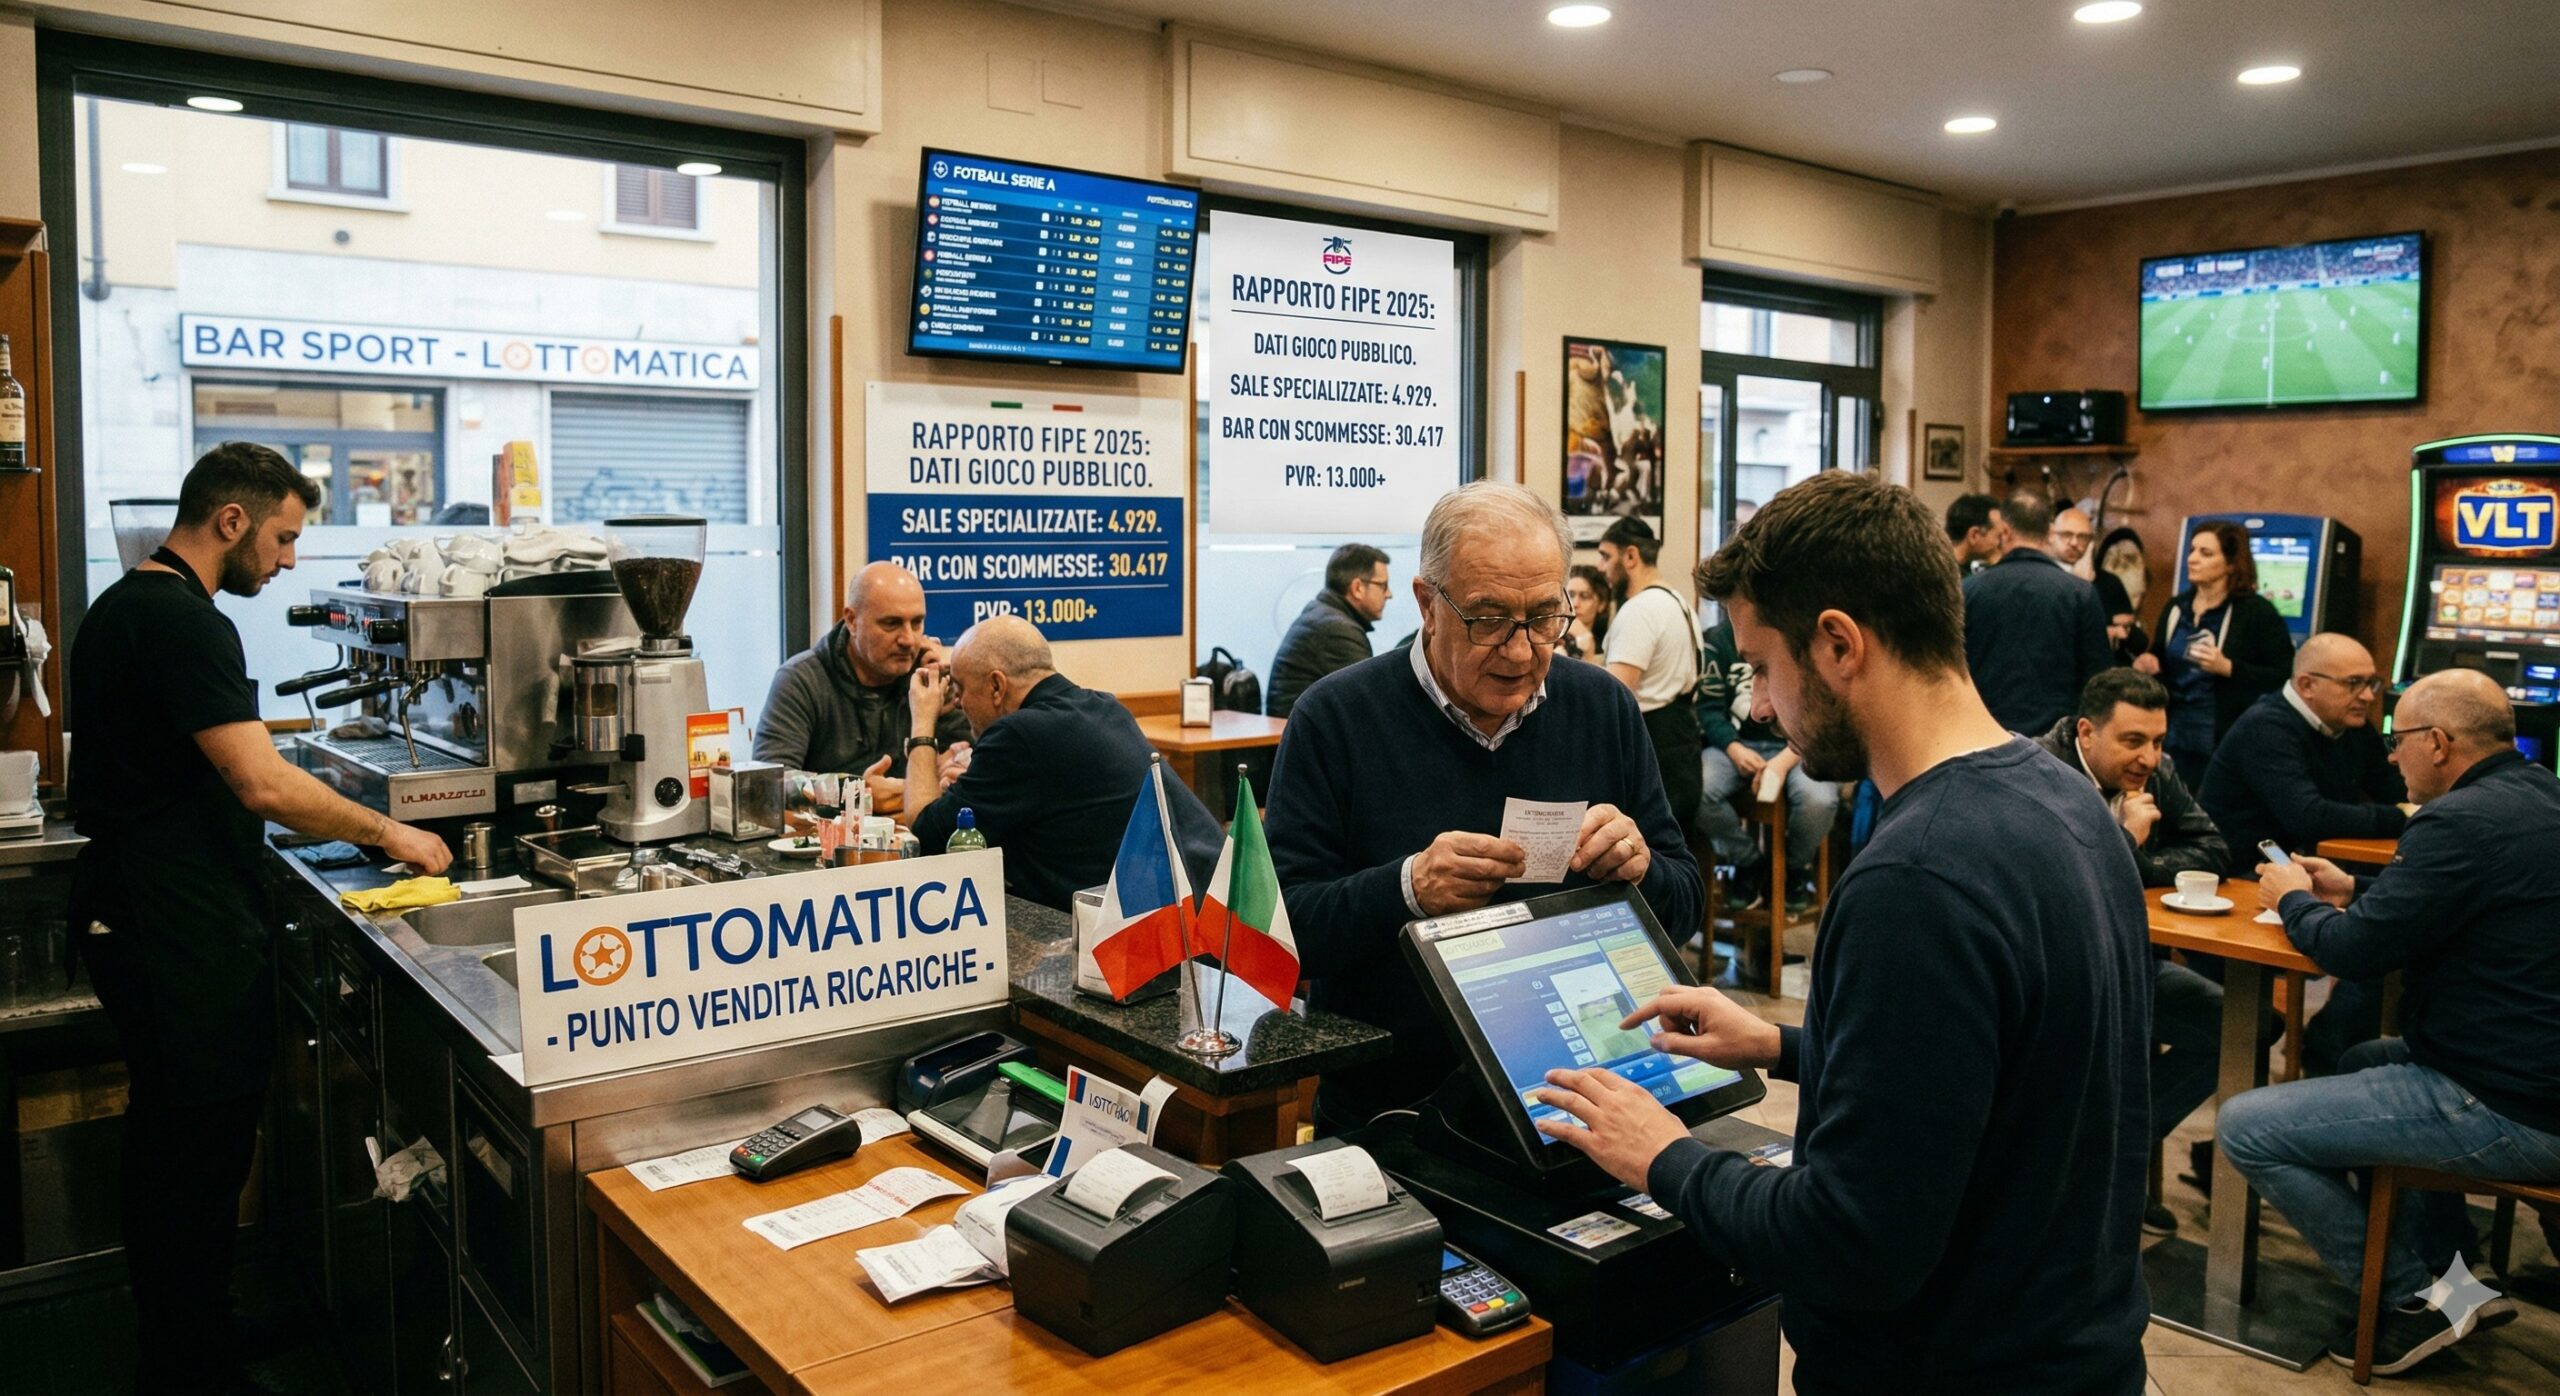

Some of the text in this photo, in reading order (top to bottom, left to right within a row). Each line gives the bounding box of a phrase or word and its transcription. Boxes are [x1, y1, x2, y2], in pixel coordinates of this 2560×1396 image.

[953, 166, 1056, 191] FOTBALL SERIE A
[1323, 254, 1352, 266] FIPE
[1232, 274, 1435, 319] RAPPORTO FIPE 2025:
[195, 324, 285, 359] BAR
[302, 330, 440, 365] SPORT
[483, 341, 748, 381] LOTTOMATICA
[1254, 333, 1416, 365] DATI GIOCO PUBBLICO.
[1230, 374, 1437, 407] SALE SPECIALIZZATE: 4.929.
[912, 422, 1151, 456] RAPPORTO FIPE 2025:
[1222, 416, 1443, 447] BAR CON SCOMMESSE: 30.417
[910, 457, 1153, 488] DATI GIOCO PUBBLICO.
[1285, 465, 1386, 488] PVR: 13.000+
[902, 508, 1162, 534] SALE SPECIALIZZATE: 4.929.
[2459, 502, 2551, 539] VLT
[937, 555, 978, 580] CON
[983, 553, 1104, 580] SCOMMESSE:
[1108, 552, 1168, 577] 30.417
[1024, 598, 1097, 624] 13.000+
[540, 877, 988, 993] LOTTOMATICA
[567, 997, 680, 1052] PUNTO
[688, 974, 820, 1030] VENDITA
[827, 948, 978, 1006] RICARICHE
